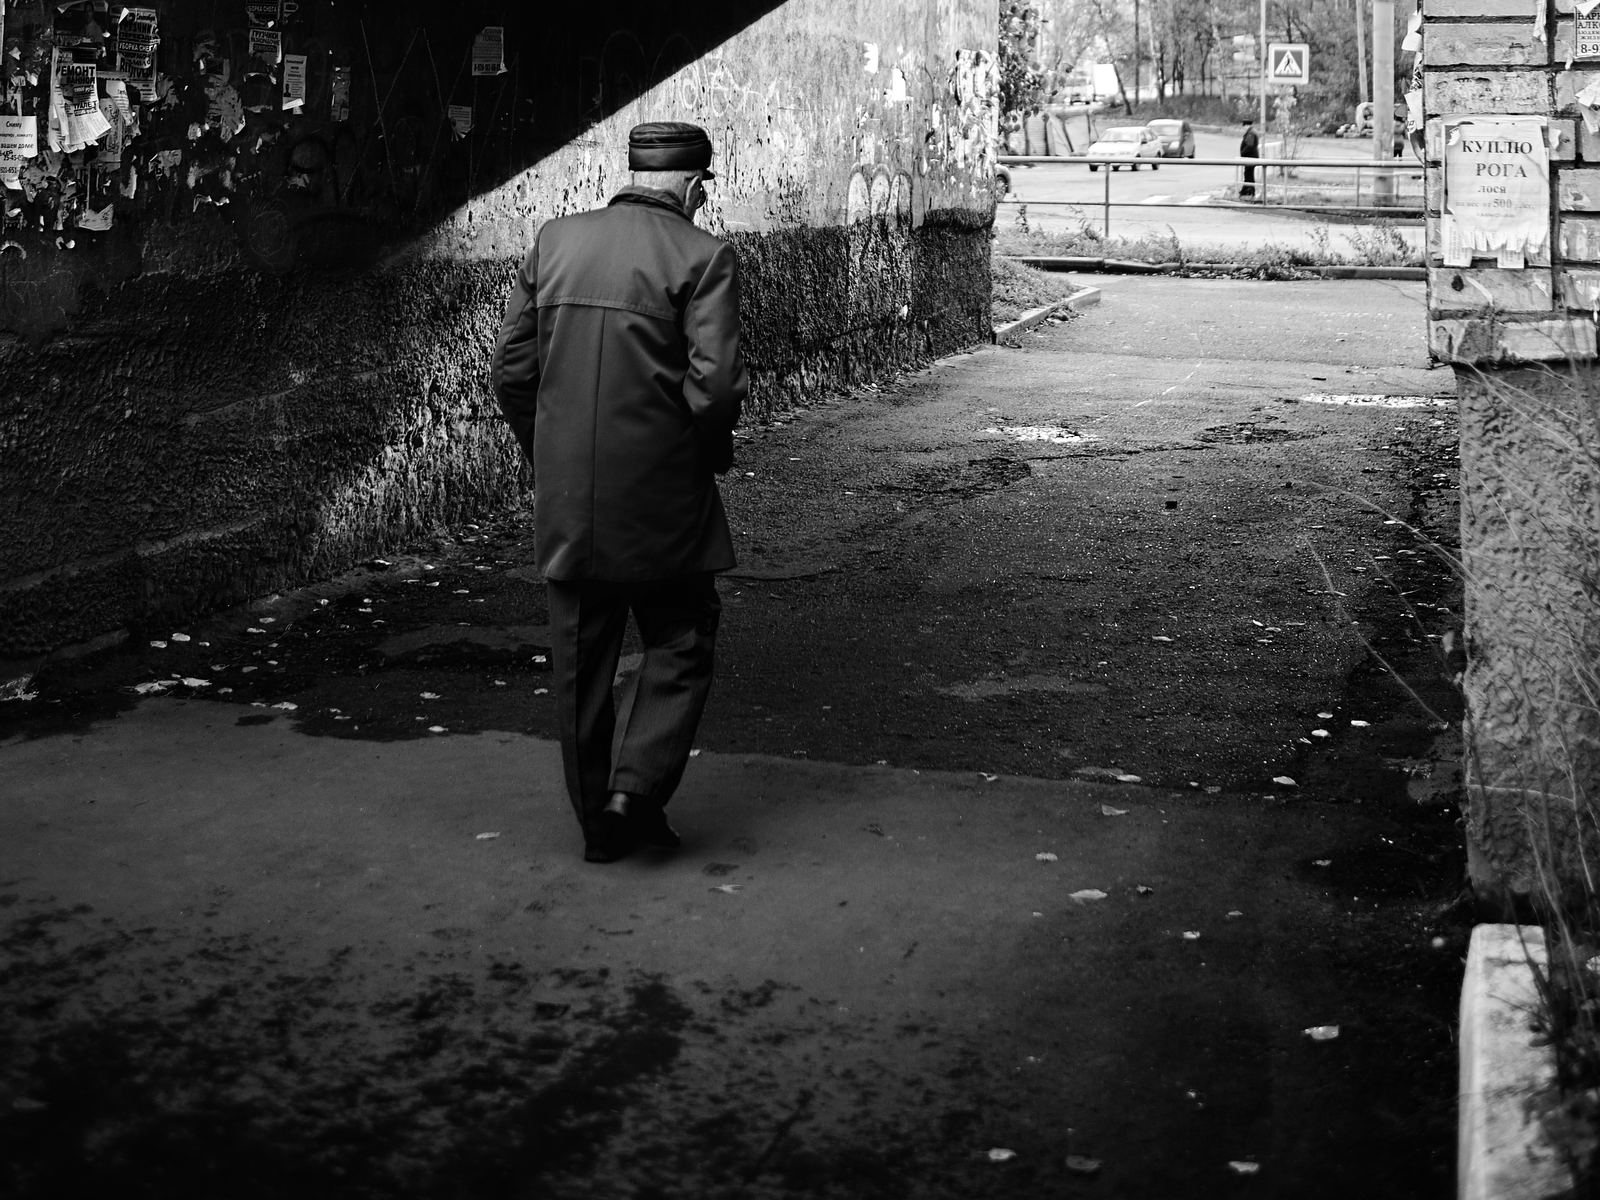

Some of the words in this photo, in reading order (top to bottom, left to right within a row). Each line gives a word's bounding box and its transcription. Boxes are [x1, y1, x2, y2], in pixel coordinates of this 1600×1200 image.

[1580, 43, 1600, 54] 8-9
[1461, 140, 1533, 155] КУПЛЮ
[1475, 162, 1528, 178] РОГА
[1477, 185, 1507, 194] лося
[1493, 198, 1512, 208] 500
